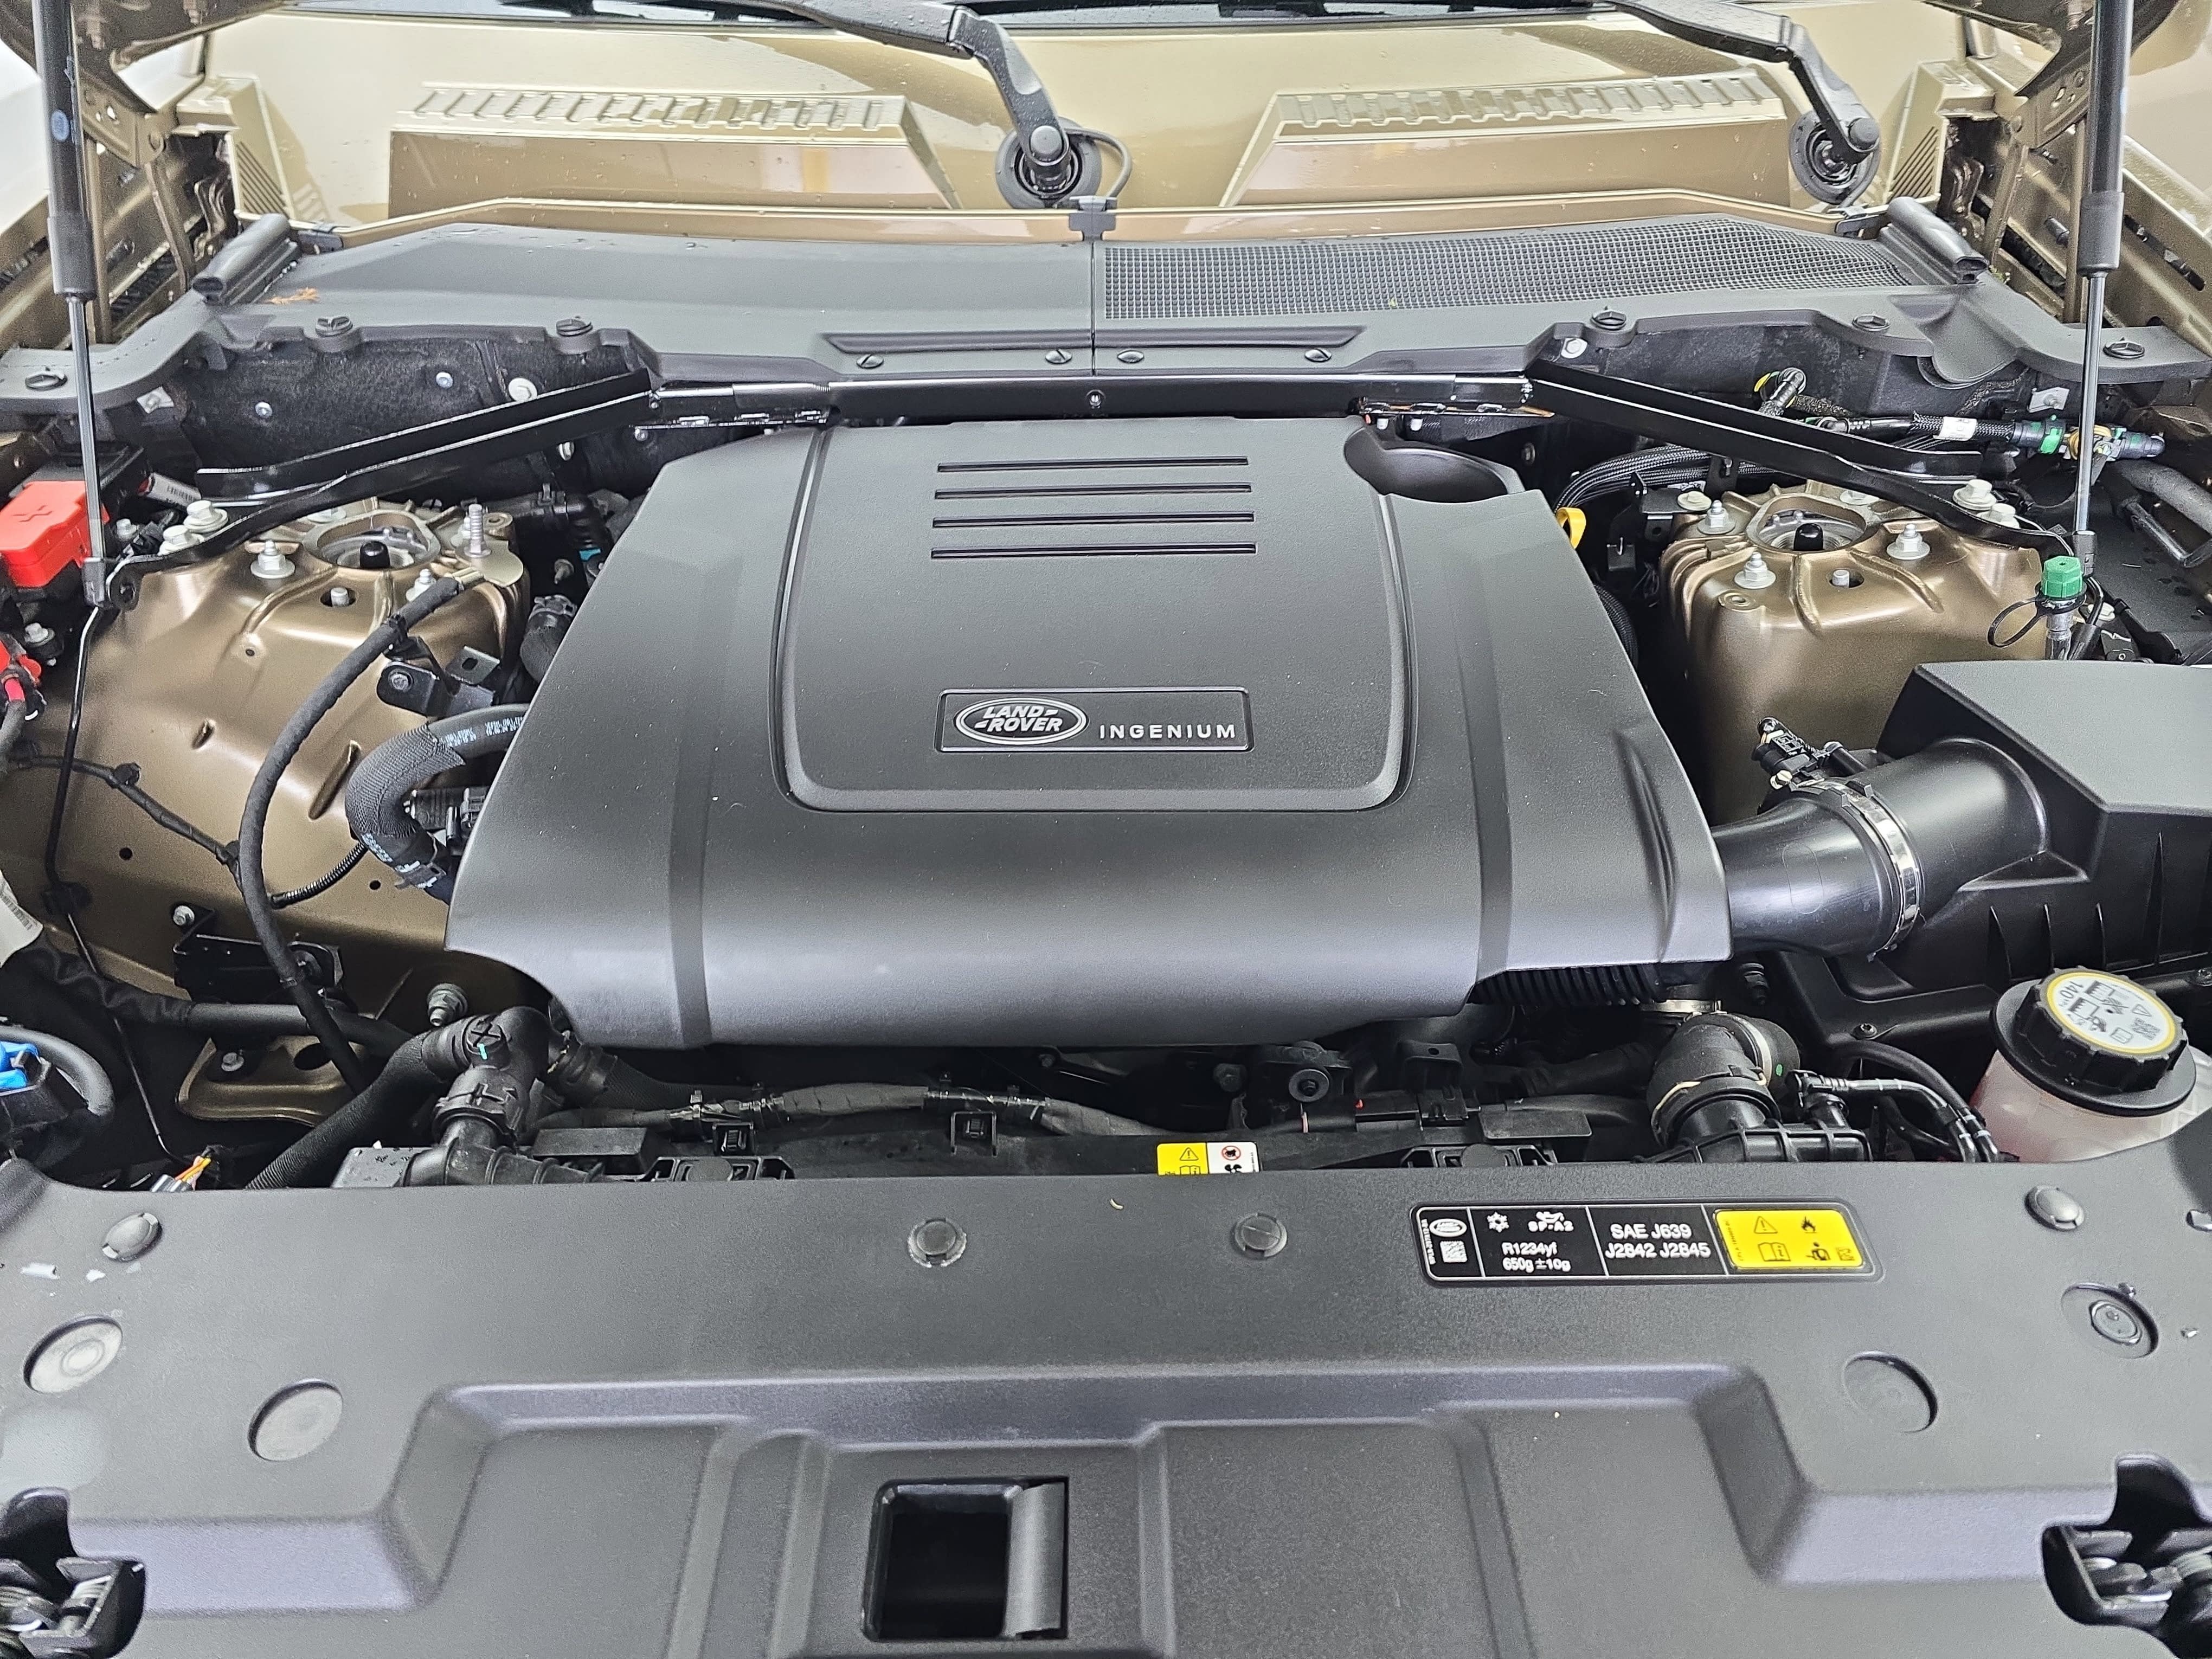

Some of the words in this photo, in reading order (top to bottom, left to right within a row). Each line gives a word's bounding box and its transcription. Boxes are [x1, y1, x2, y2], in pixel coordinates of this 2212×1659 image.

[982, 705, 1045, 719] LAND
[987, 717, 1063, 732] ROVER
[1099, 724, 1236, 739] INGENIUM
[1610, 1223, 1649, 1239] SAE
[1651, 1223, 1692, 1239] J639
[1501, 1242, 1558, 1257] R1234yf
[1605, 1242, 1657, 1258] J2842
[1659, 1242, 1712, 1258] J2845
[1502, 1257, 1534, 1273] 650g
